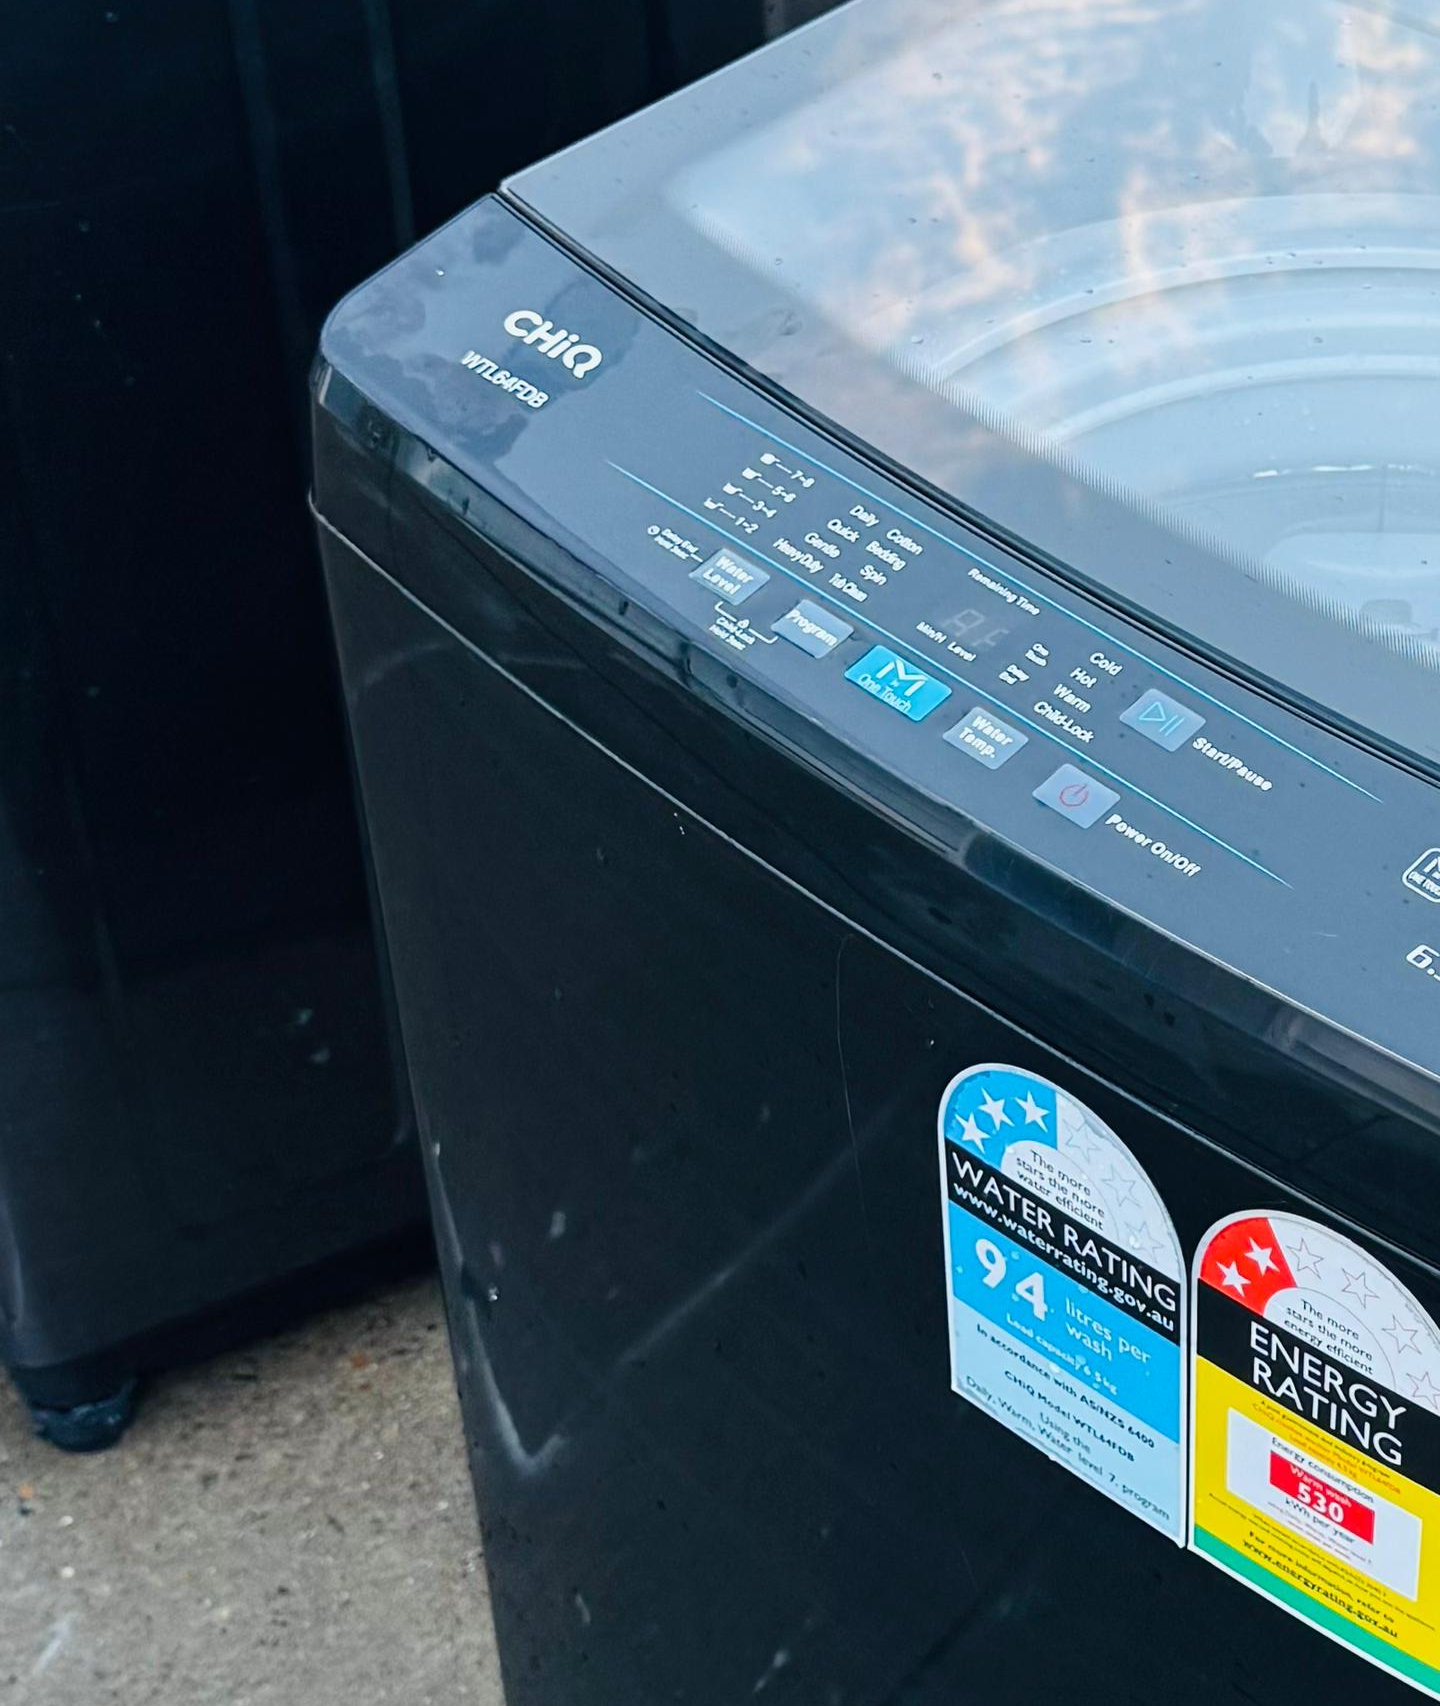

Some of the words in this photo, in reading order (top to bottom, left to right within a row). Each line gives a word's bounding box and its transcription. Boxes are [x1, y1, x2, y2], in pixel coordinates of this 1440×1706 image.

[504, 310, 602, 379] CHiQ
[461, 350, 549, 408] WTL64FDB
[827, 518, 860, 543] Quick
[849, 504, 880, 526] Daily
[804, 532, 841, 558] Gentle
[865, 540, 906, 571] Bedding
[886, 529, 924, 555] Cotton
[702, 567, 741, 595] Level
[715, 556, 754, 583] Water
[859, 564, 887, 586] Spin
[968, 568, 1018, 603] Remaining
[1016, 596, 1040, 615] Time
[785, 608, 838, 647] Program
[947, 641, 977, 661] Level
[1089, 652, 1123, 676] Cold
[858, 674, 882, 696] One
[881, 686, 913, 714] Touch
[1052, 683, 1092, 713] Warm
[1069, 667, 1098, 688] Hot
[959, 726, 996, 758] Temp.
[971, 715, 1013, 746] Water
[1033, 701, 1095, 743] Child-Lock
[1192, 737, 1273, 791] Start/Pause
[1104, 813, 1153, 847] Power
[1150, 842, 1201, 877] On/Off
[1017, 1157, 1046, 1180] stars
[1048, 1173, 1069, 1195] the
[1071, 1192, 1106, 1218] more
[1030, 1149, 1055, 1174] The
[1058, 1171, 1091, 1196] more
[1017, 1171, 1052, 1197] water
[1056, 1195, 1104, 1231] efficient
[952, 1151, 1056, 1238] WATER
[1063, 1223, 1176, 1312] RATING
[953, 1182, 1174, 1332] www.waterrating.gov.au
[1006, 1313, 1034, 1339] Load
[1065, 1297, 1113, 1342] litres
[1118, 1335, 1152, 1364] per
[1285, 1306, 1314, 1329] stars
[1317, 1324, 1337, 1342] the
[1340, 1337, 1373, 1361] more
[1301, 1298, 1323, 1317] The
[1327, 1316, 1360, 1340] more
[1065, 1322, 1113, 1361] wash
[1283, 1319, 1323, 1347] energy
[1326, 1343, 1374, 1375] efficient
[976, 1323, 988, 1335] In
[990, 1336, 1051, 1383] accordance
[1053, 1376, 1078, 1398] with
[1080, 1394, 1125, 1430] AS/NZS
[1128, 1422, 1155, 1449] 6400
[1250, 1320, 1407, 1430] ENERGY
[1037, 1392, 1071, 1420] Model
[1253, 1356, 1402, 1466] RATING
[1039, 1411, 1070, 1443] Using
[1072, 1434, 1091, 1453] the
[1037, 1425, 1073, 1454] Water
[1078, 1451, 1103, 1476] level
[1122, 1484, 1171, 1520] program
[1271, 1436, 1305, 1463] Energy
[1307, 1460, 1375, 1503] consumption
[1289, 1464, 1324, 1493] Warm
[1325, 1486, 1352, 1508] wash
[1285, 1497, 1311, 1518] kWh
[1312, 1515, 1330, 1530] per
[1332, 1526, 1356, 1544] year
[1297, 1483, 1344, 1524] 530
